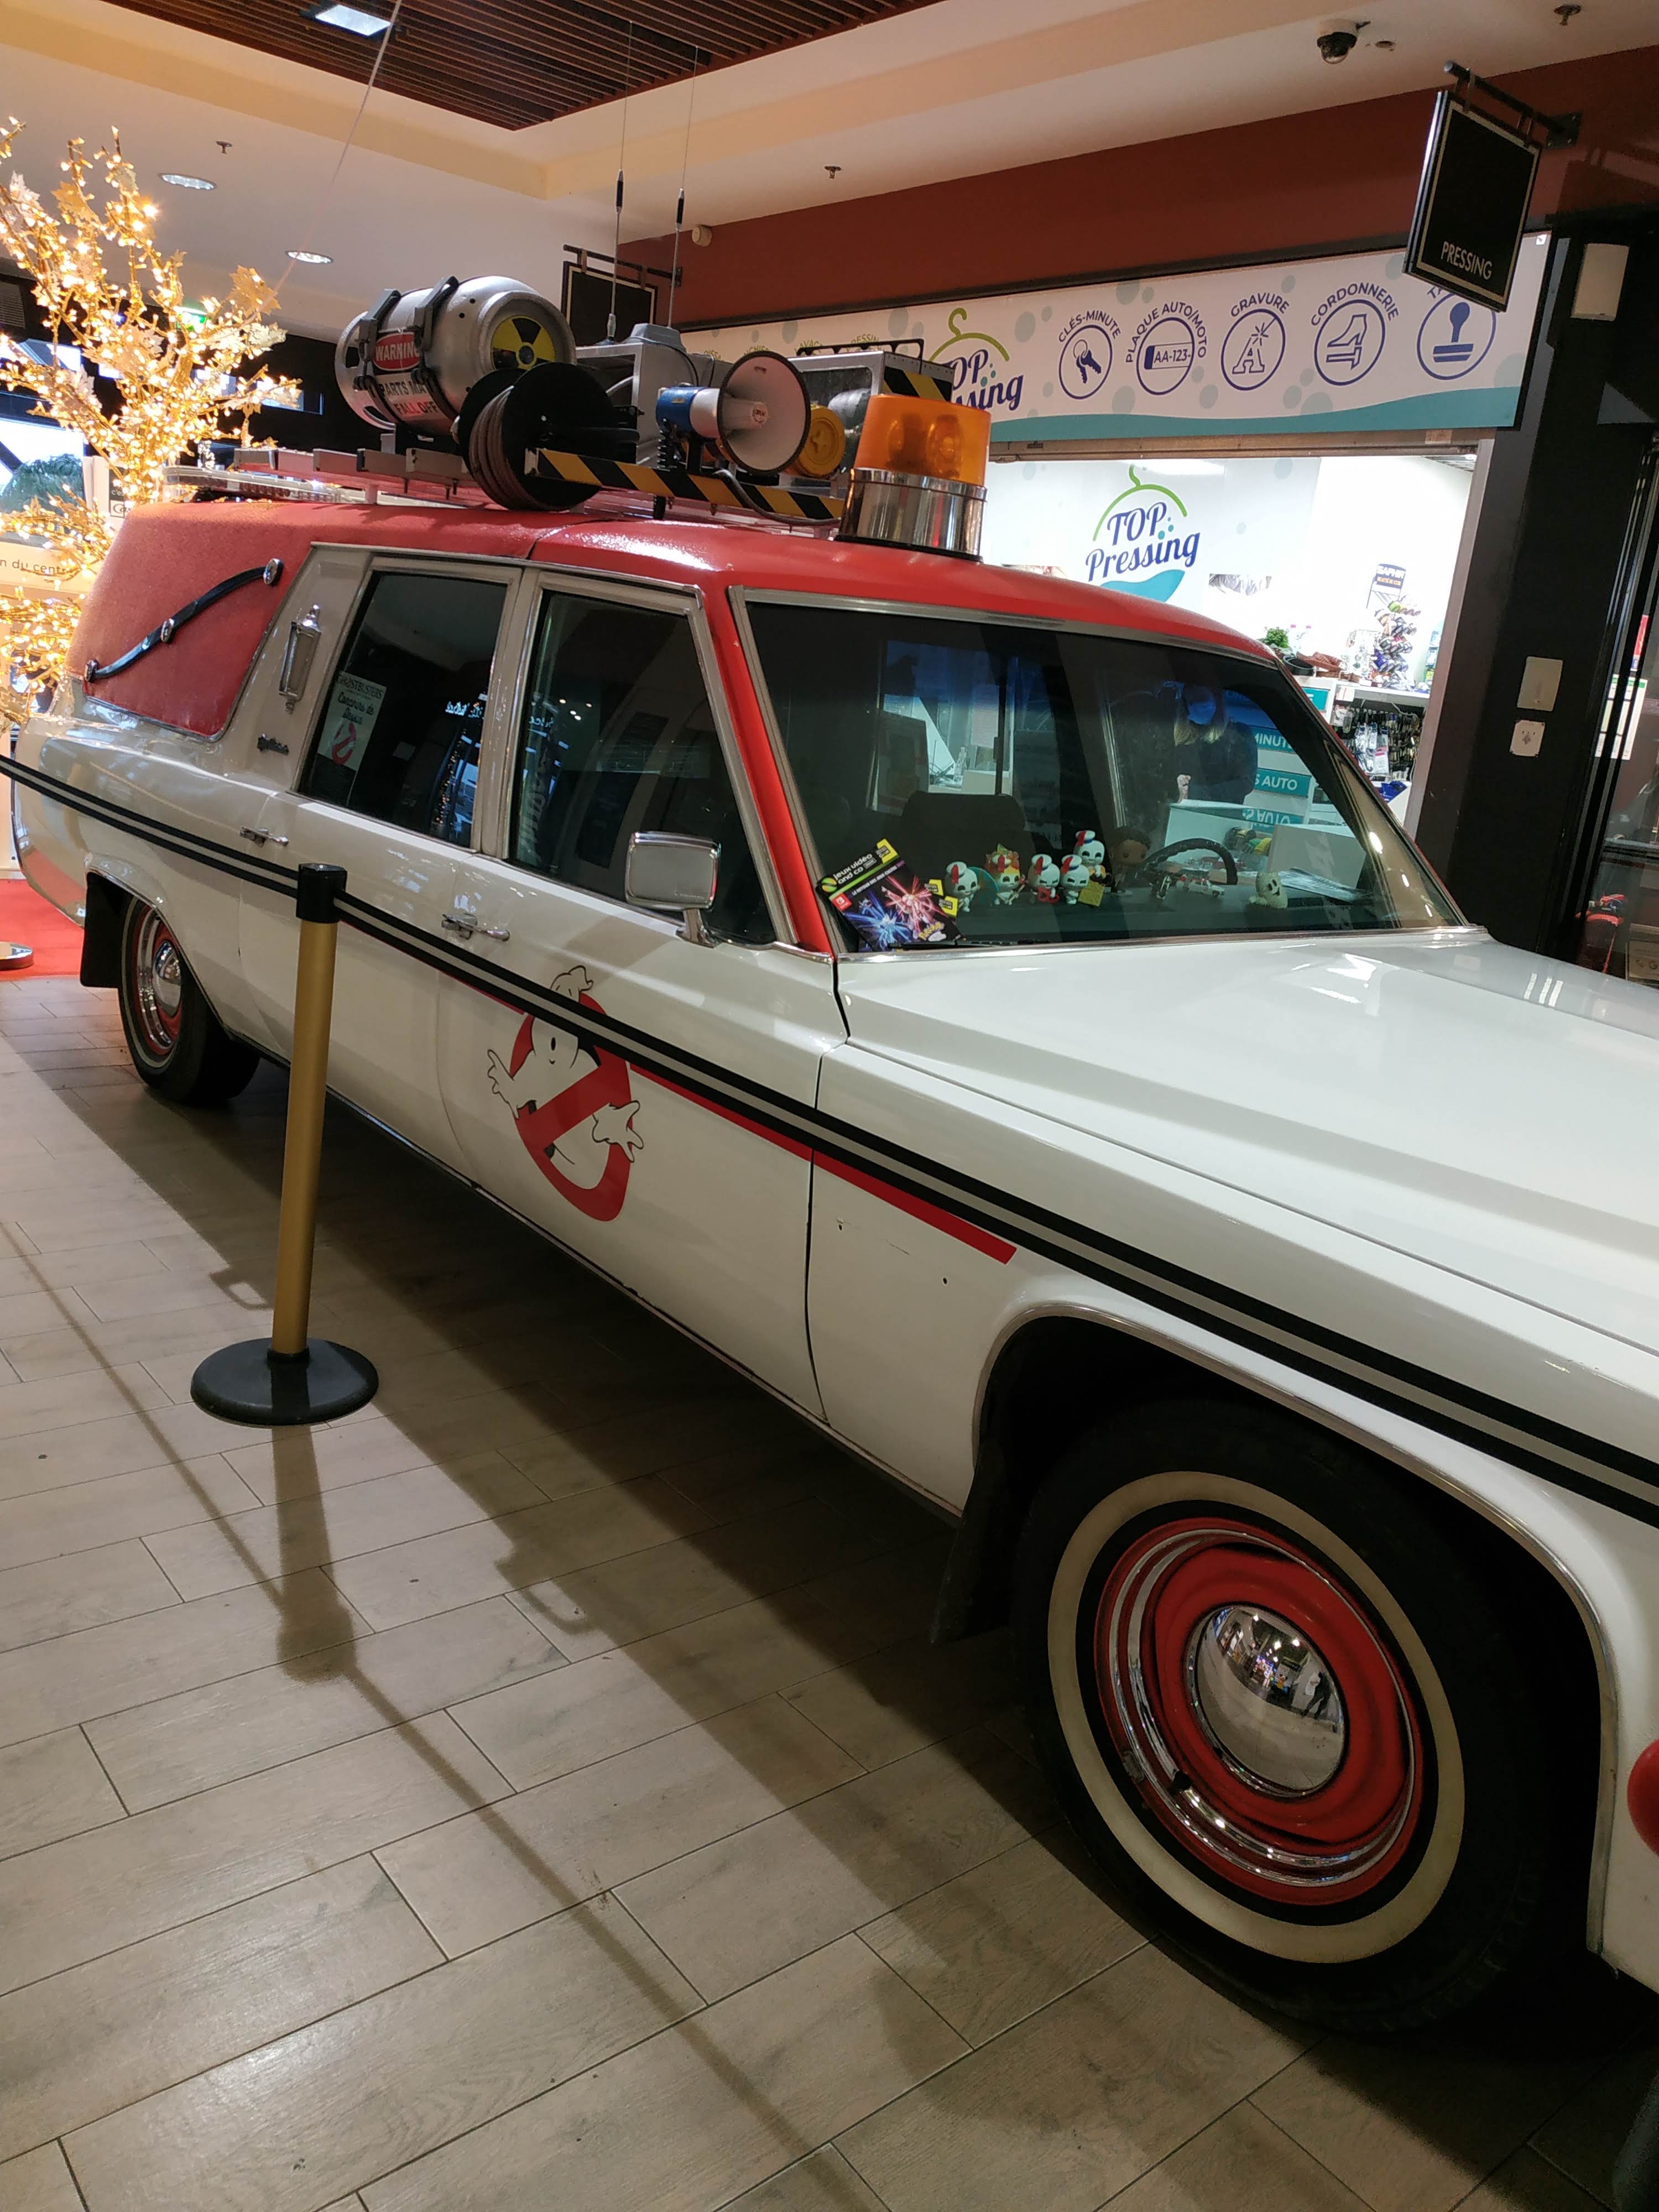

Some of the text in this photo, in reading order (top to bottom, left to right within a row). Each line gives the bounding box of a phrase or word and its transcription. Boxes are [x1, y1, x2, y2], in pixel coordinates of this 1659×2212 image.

[1441, 241, 1493, 280] PRESSING
[1230, 293, 1290, 317] GRAVURE
[1311, 282, 1399, 327] CORDONNERIE
[1058, 310, 1121, 342] CLÉS-MINUTE
[1125, 301, 1207, 363] PLAQUE AUTO/MOTO
[408, 379, 427, 394] MA
[941, 349, 989, 390] OP
[393, 401, 439, 415] FALL OFF
[1107, 502, 1167, 546] TOP
[1085, 532, 1201, 582] Pressing
[1261, 775, 1297, 791] AUTO
